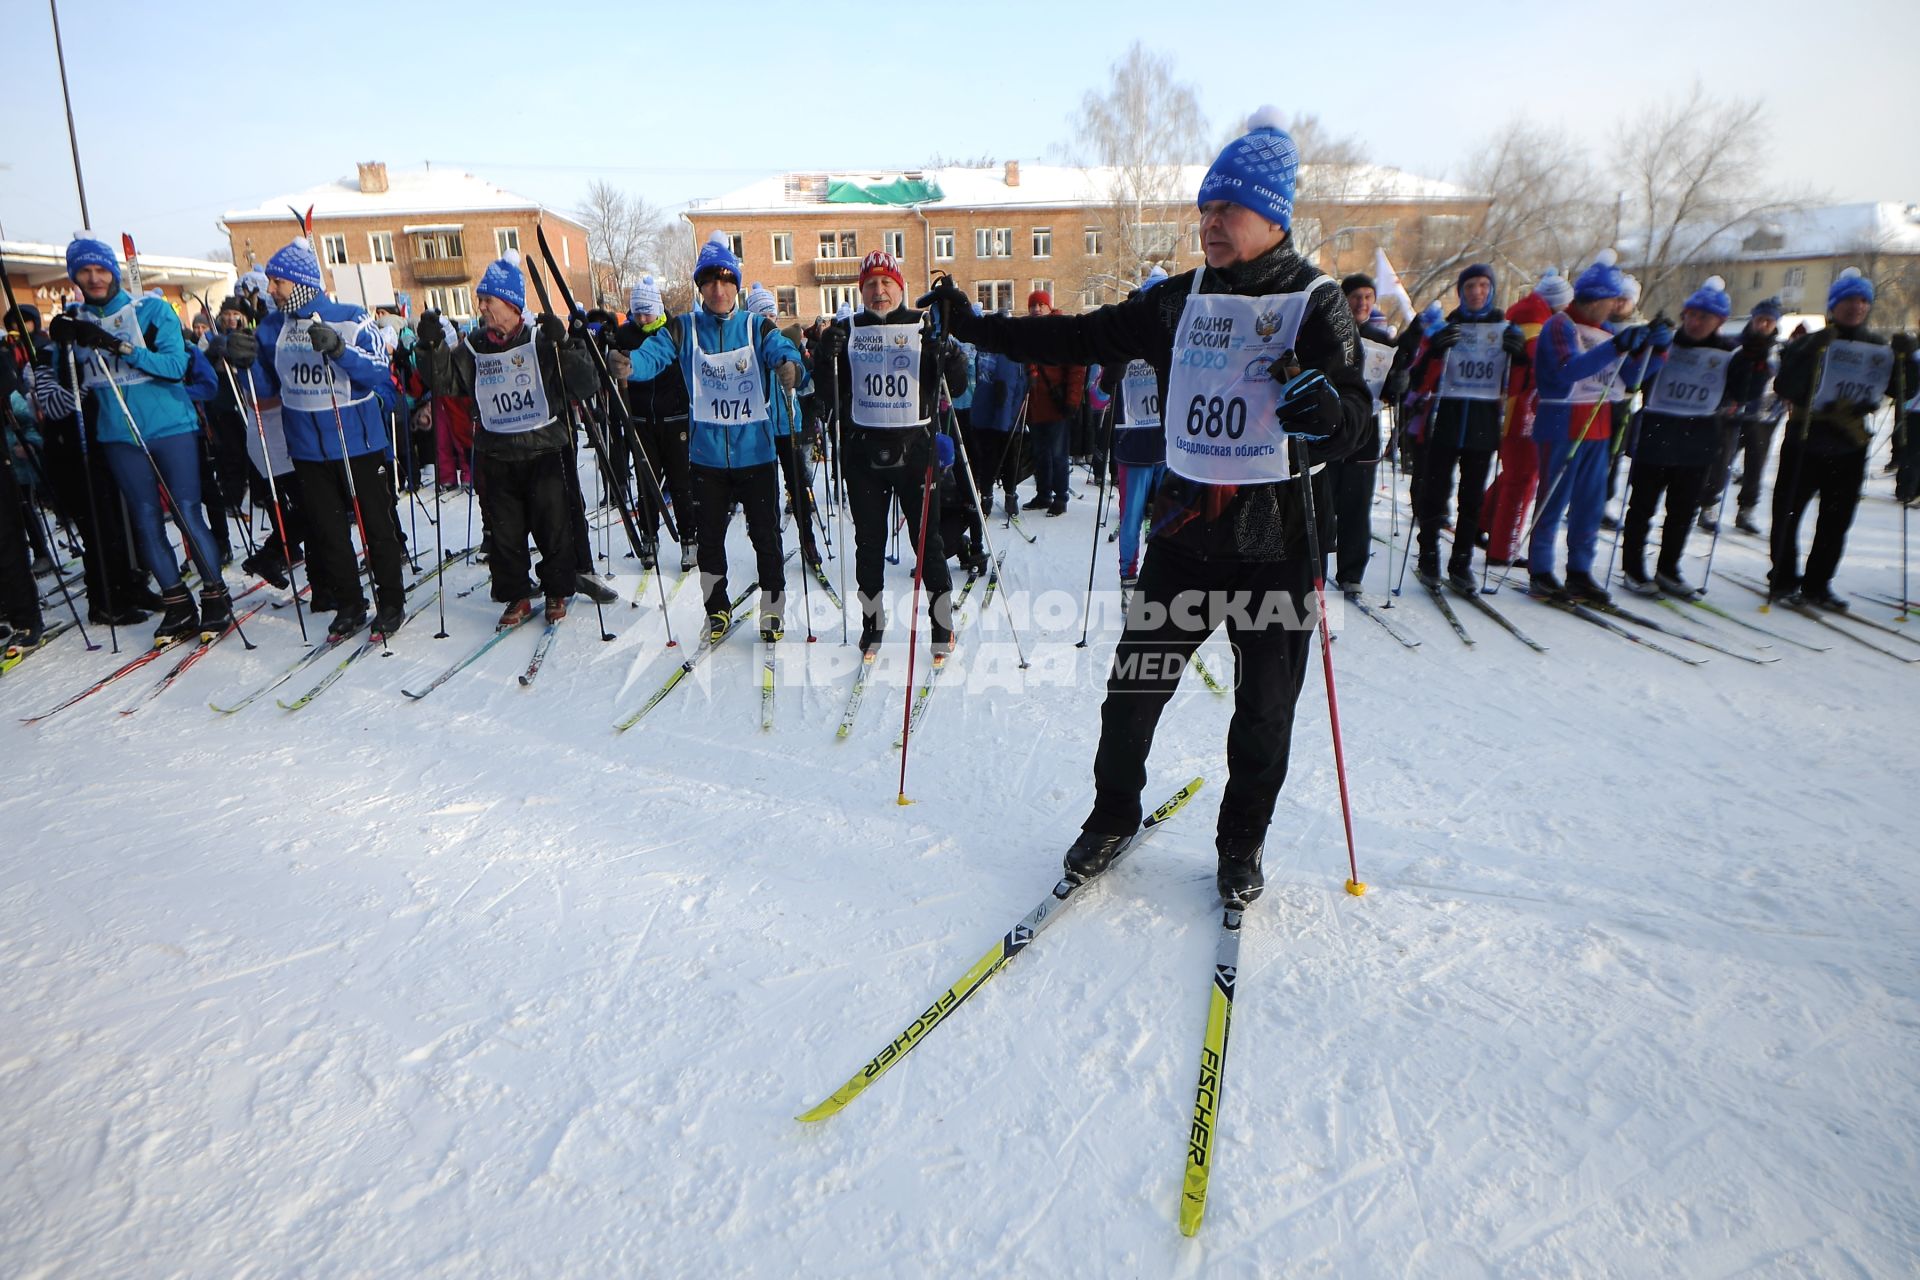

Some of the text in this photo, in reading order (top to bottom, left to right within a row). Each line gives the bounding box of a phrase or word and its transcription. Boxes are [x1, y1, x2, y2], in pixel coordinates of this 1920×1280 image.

[853, 343, 884, 352] РОССИИ
[1187, 330, 1231, 349] РОССИИ
[852, 352, 884, 363] 2020
[1180, 350, 1228, 370] 2020
[480, 366, 503, 376] РОССИИ
[1459, 360, 1494, 379] 1036
[480, 375, 506, 385] 2020
[702, 377, 729, 391] 2020
[865, 373, 908, 398] 1080
[492, 389, 535, 414] 1034
[711, 397, 752, 420] 1074
[858, 399, 913, 409] Свердловская область
[1142, 395, 1159, 415] 10
[489, 412, 541, 425] Свердловская область
[1186, 394, 1247, 440] 680
[1176, 435, 1275, 458] Свердловская область
[864, 989, 957, 1078] FISCHER
[1188, 1047, 1219, 1167] FISCHER
